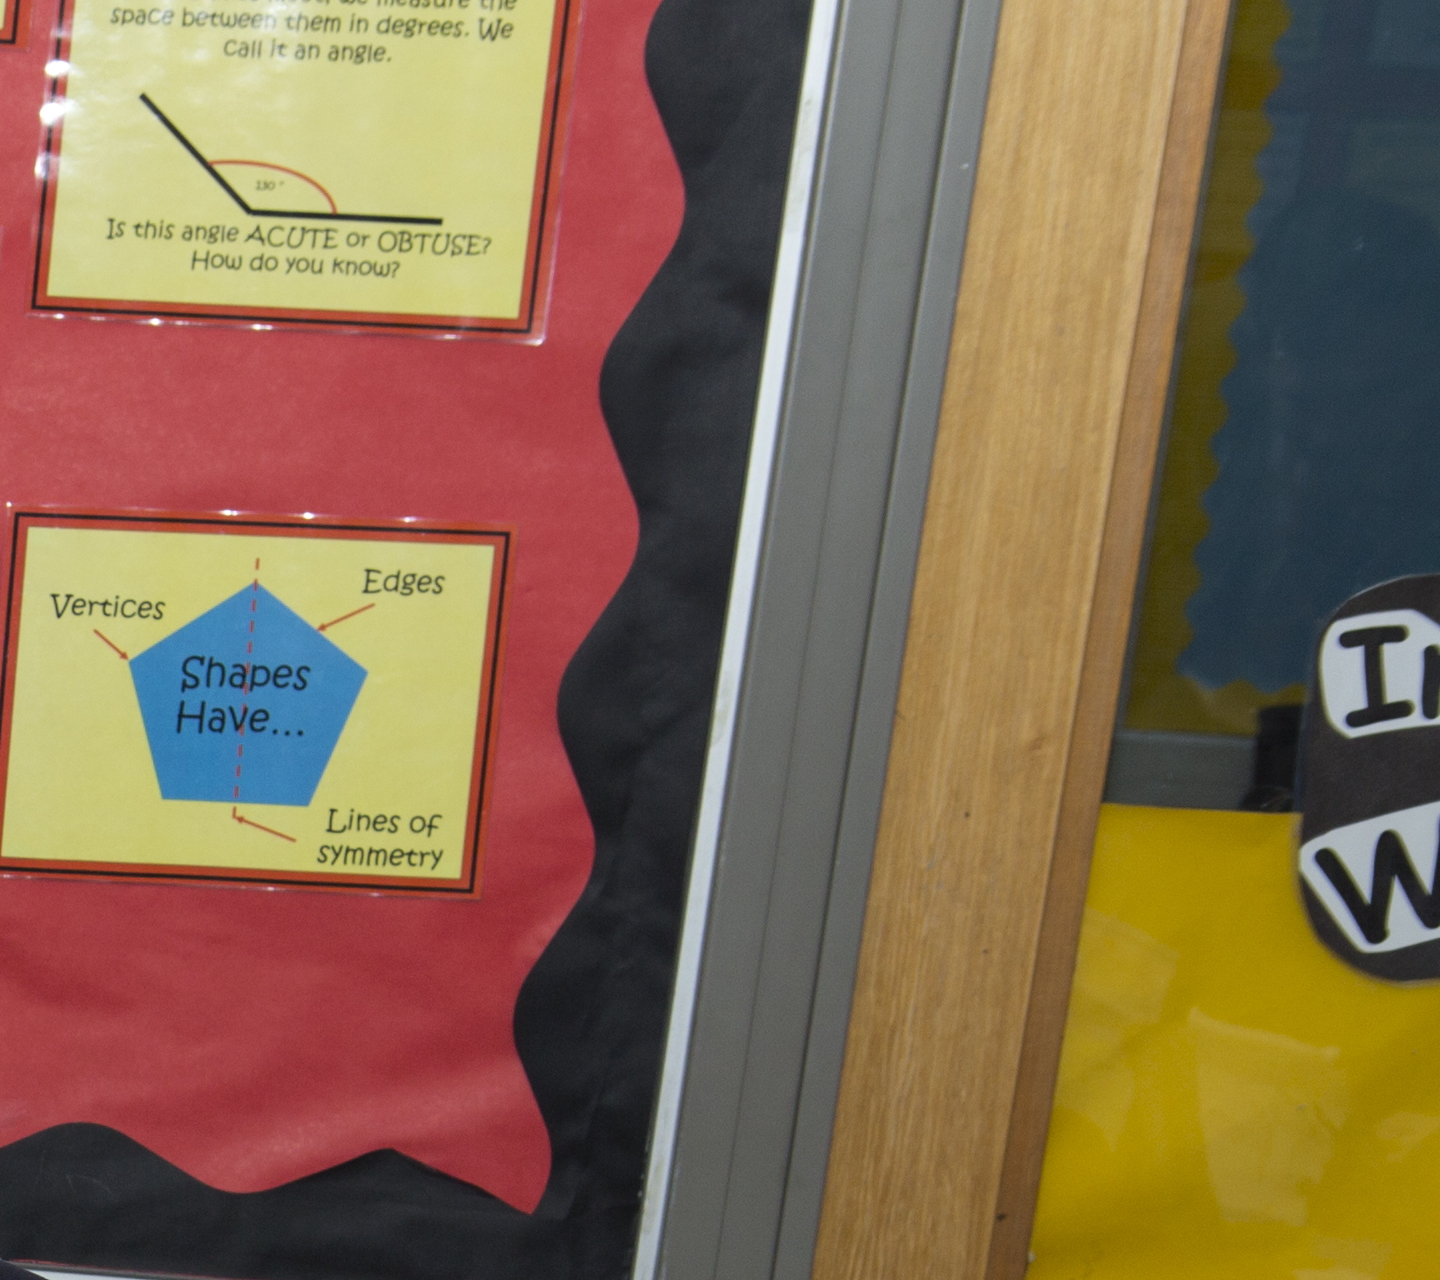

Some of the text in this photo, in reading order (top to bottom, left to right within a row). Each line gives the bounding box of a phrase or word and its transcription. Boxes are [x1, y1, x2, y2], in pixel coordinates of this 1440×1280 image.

[109, 7, 514, 42] space between them in degrees. We
[269, 38, 288, 58] it
[294, 43, 321, 61] an
[327, 44, 391, 65] angle.
[106, 217, 492, 257] Is this angle ACUTE or OBTUSE?
[191, 250, 401, 278] How do you know?
[362, 568, 446, 597] Edges
[50, 593, 166, 621] Vertices
[180, 655, 310, 692] Shapes
[176, 700, 304, 736] Have...
[325, 808, 443, 838] Lines of
[317, 844, 444, 871] symmetry
